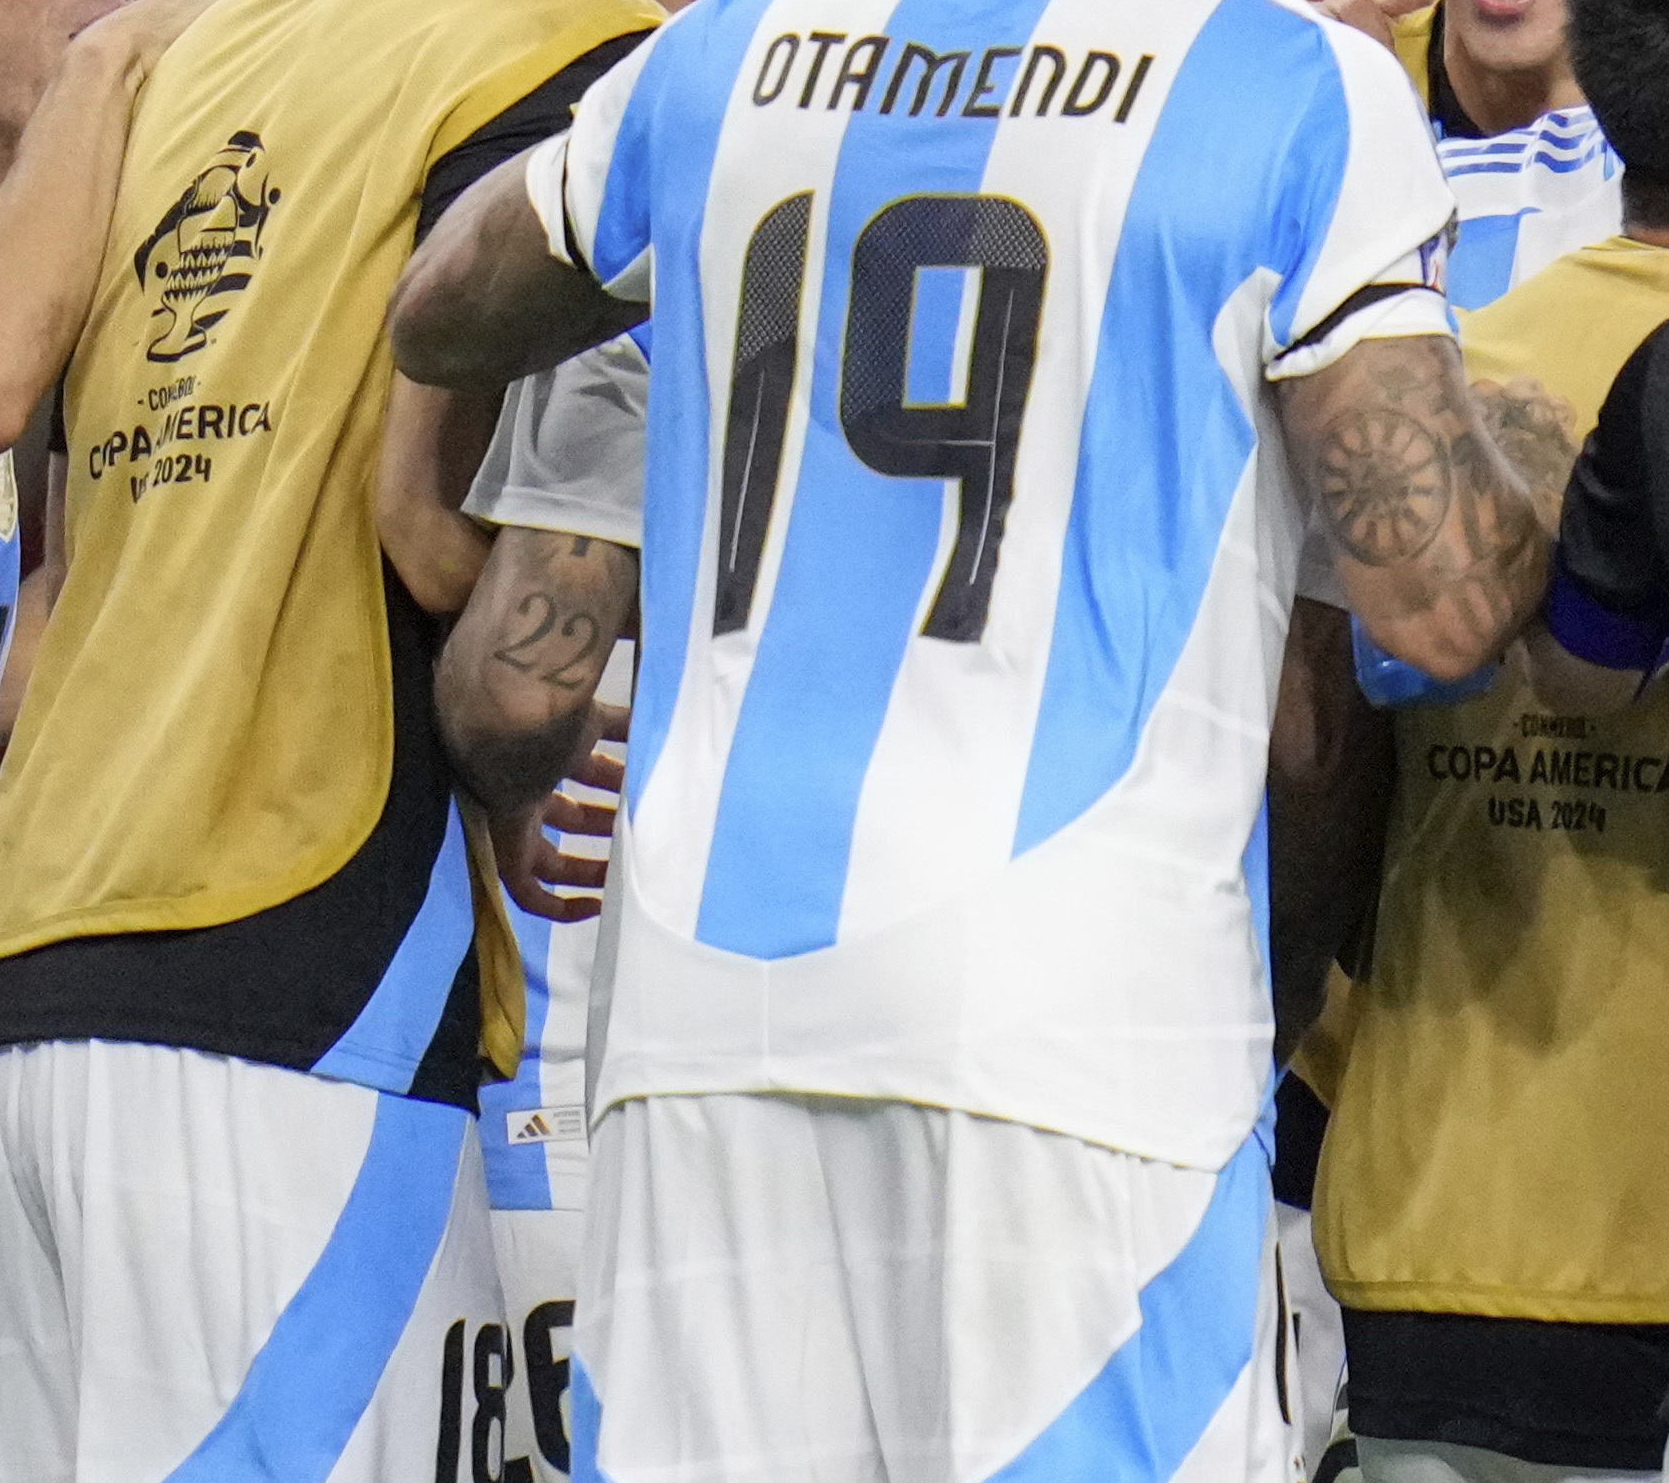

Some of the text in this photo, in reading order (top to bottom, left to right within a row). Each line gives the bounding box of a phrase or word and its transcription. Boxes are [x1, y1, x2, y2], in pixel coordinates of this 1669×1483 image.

[752, 31, 1156, 123] OTAMENDI
[712, 190, 1051, 644] 19
[153, 453, 211, 487] 2024
[1427, 744, 1521, 784] COPA
[1488, 797, 1608, 832] USA 2024
